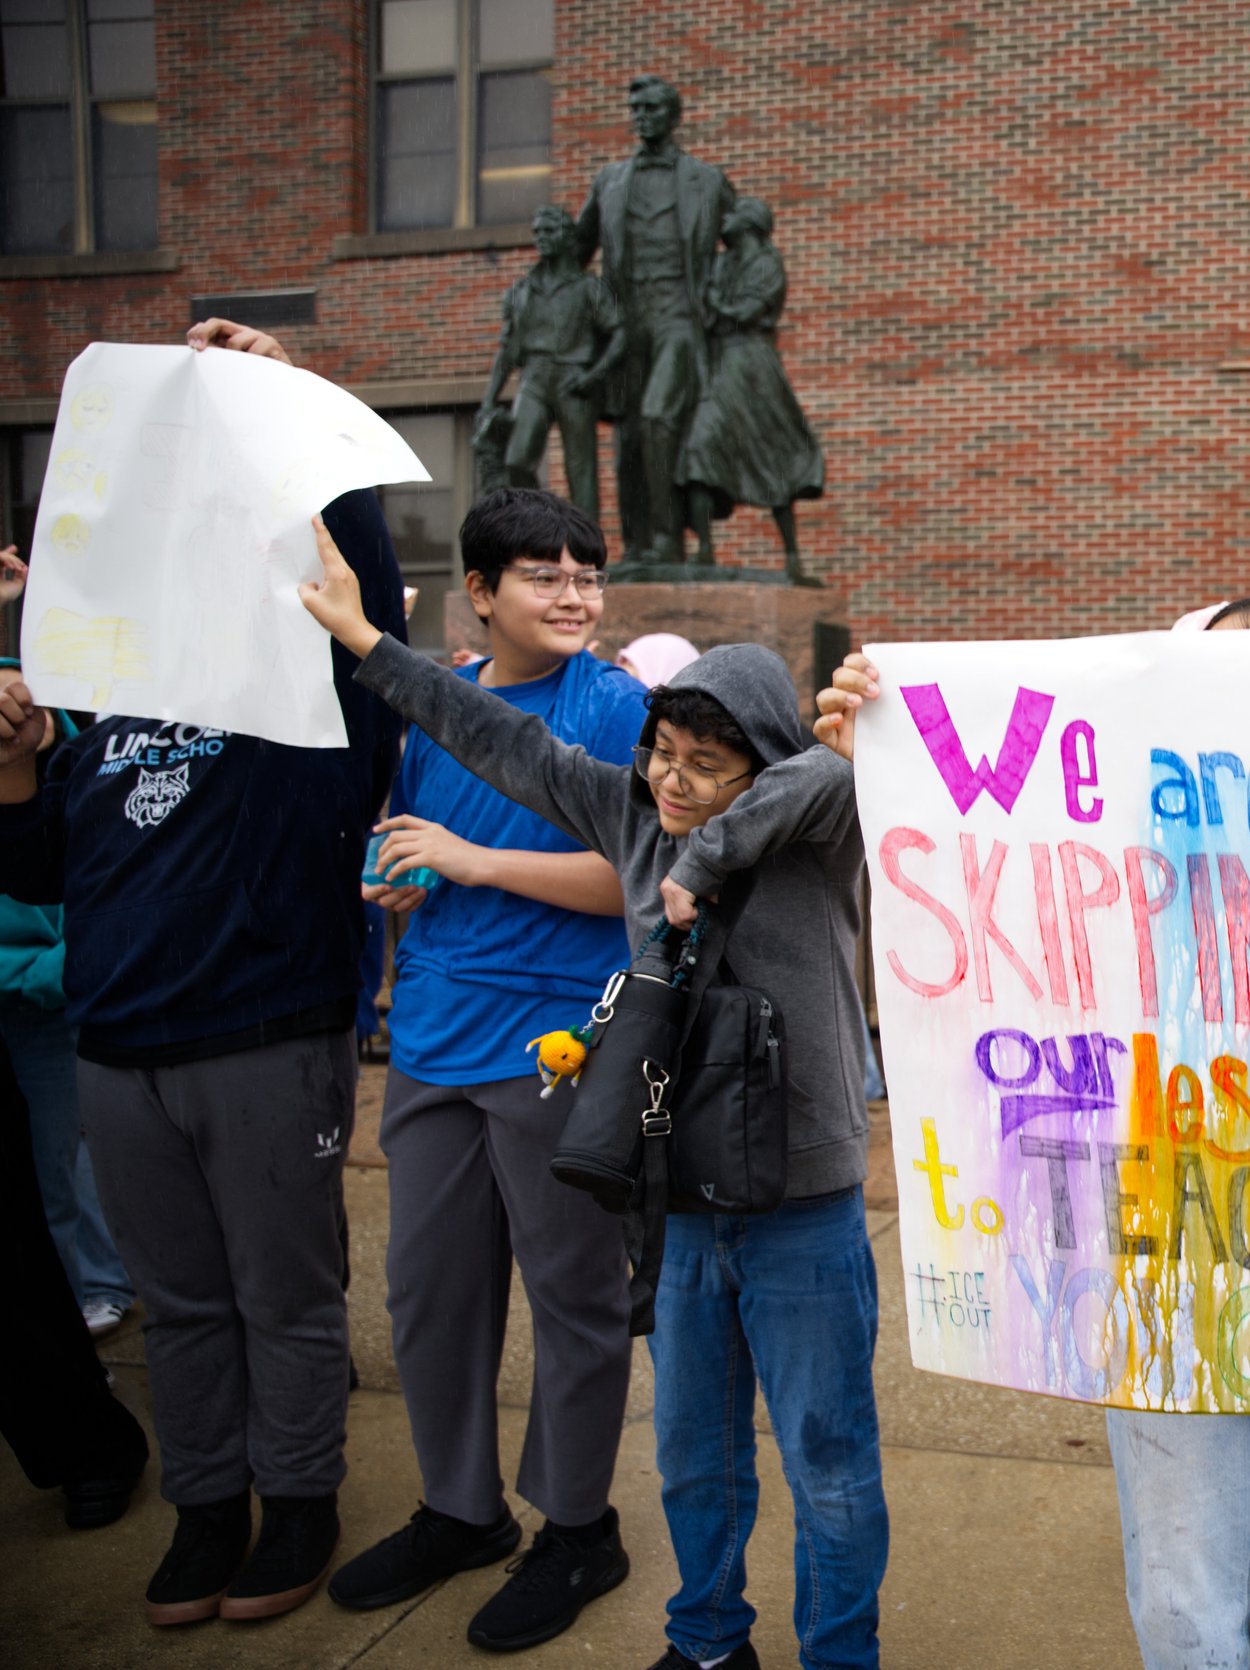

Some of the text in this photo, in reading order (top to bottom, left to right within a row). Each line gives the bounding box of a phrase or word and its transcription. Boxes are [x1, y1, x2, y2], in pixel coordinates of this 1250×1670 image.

[899, 682, 1104, 823] We
[975, 1028, 1127, 1095] our
[912, 1116, 1002, 1237] to
[949, 1303, 992, 1329] OUT
[1011, 1254, 1195, 1401] YOU
